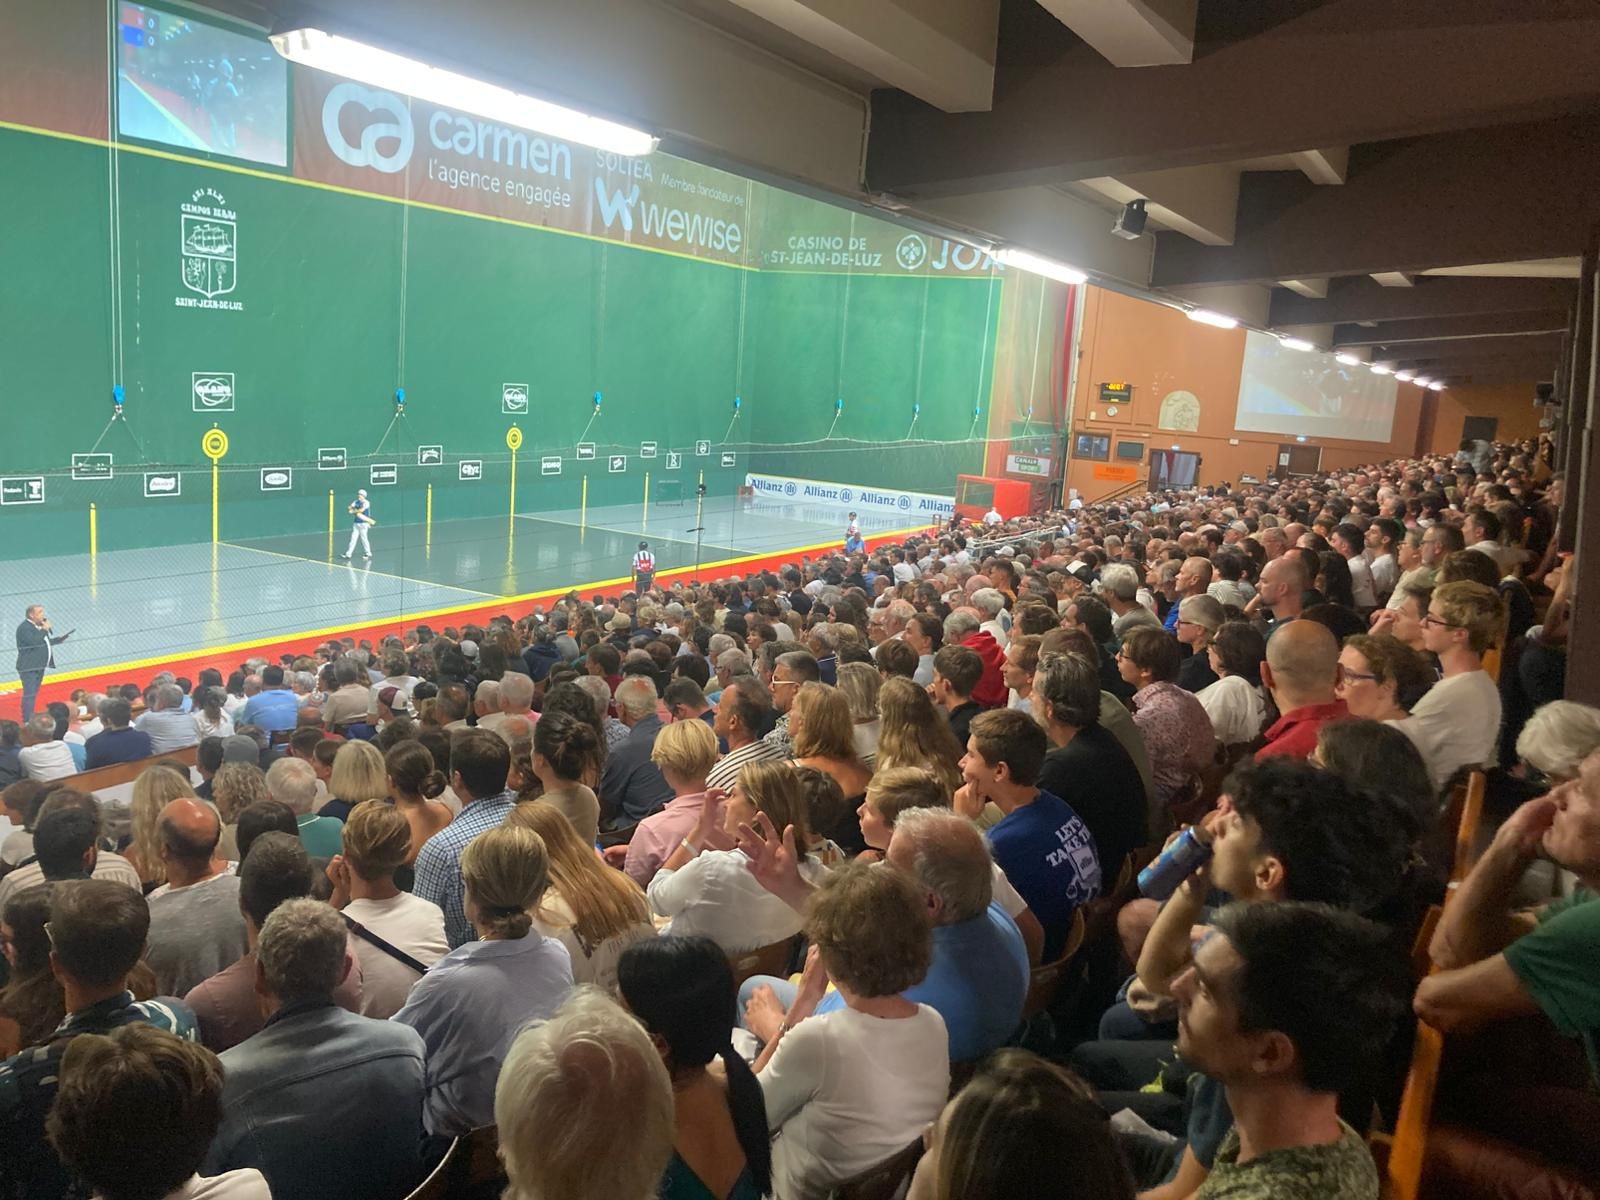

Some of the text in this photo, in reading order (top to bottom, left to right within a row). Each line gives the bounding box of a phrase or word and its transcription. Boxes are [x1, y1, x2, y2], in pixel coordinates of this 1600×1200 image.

[429, 111, 572, 180] carmen
[595, 149, 653, 182] SOLTEA
[428, 158, 571, 208] l'agence engagée
[661, 173, 696, 193] Membre
[640, 200, 742, 254] wewise
[788, 236, 867, 251] CASINO DE
[770, 250, 882, 267] ST-JEAN-DE-LUZ
[175, 297, 243, 311] SAINT-JEAN-DE-LUZ
[752, 479, 783, 493] Allianz
[804, 485, 838, 499] Allianz
[860, 492, 896, 506] Allianz
[918, 499, 955, 513] Allianz
[1046, 835, 1082, 867] TAKE
